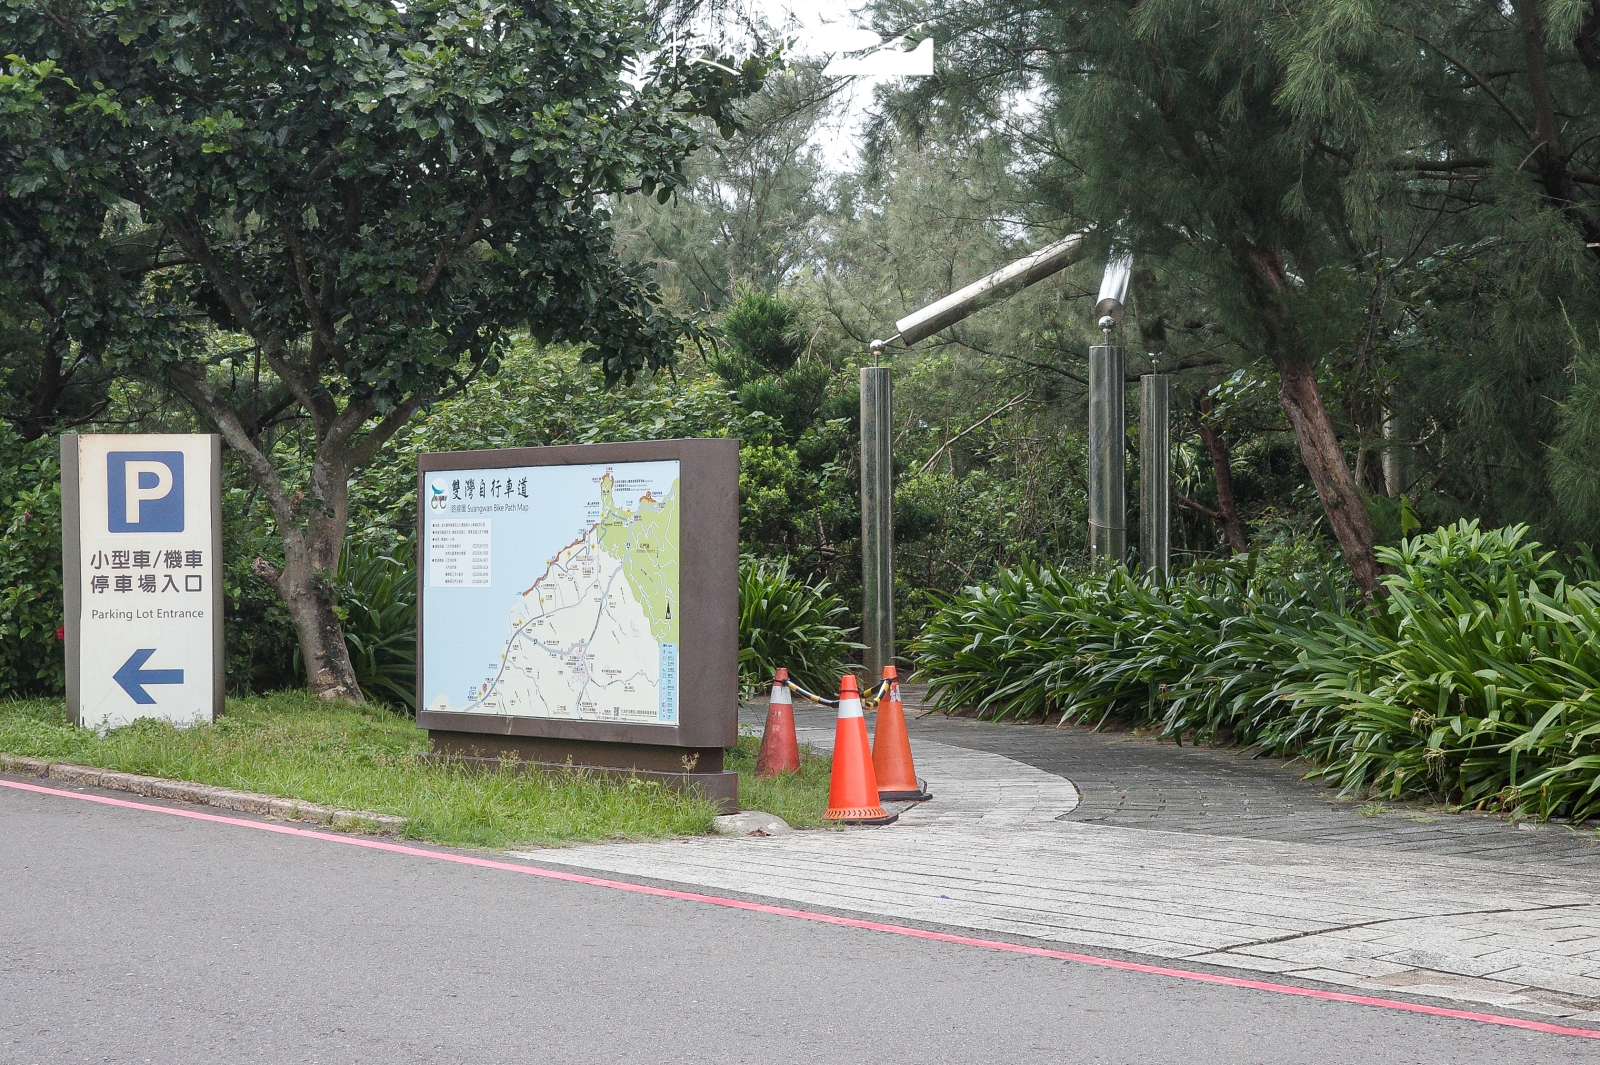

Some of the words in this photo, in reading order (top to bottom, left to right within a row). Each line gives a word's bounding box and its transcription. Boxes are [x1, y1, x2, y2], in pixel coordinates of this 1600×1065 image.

[126, 461, 173, 524] P
[452, 476, 529, 500] 雙灣自行車道
[494, 503, 504, 512] Bike
[504, 502, 516, 512] Path
[517, 502, 529, 512] Map
[90, 550, 203, 570] 小型車/機車
[90, 574, 202, 594] 停車場入口
[92, 609, 133, 622] Parking
[136, 609, 154, 618] Lot
[157, 608, 204, 618] Entrance
